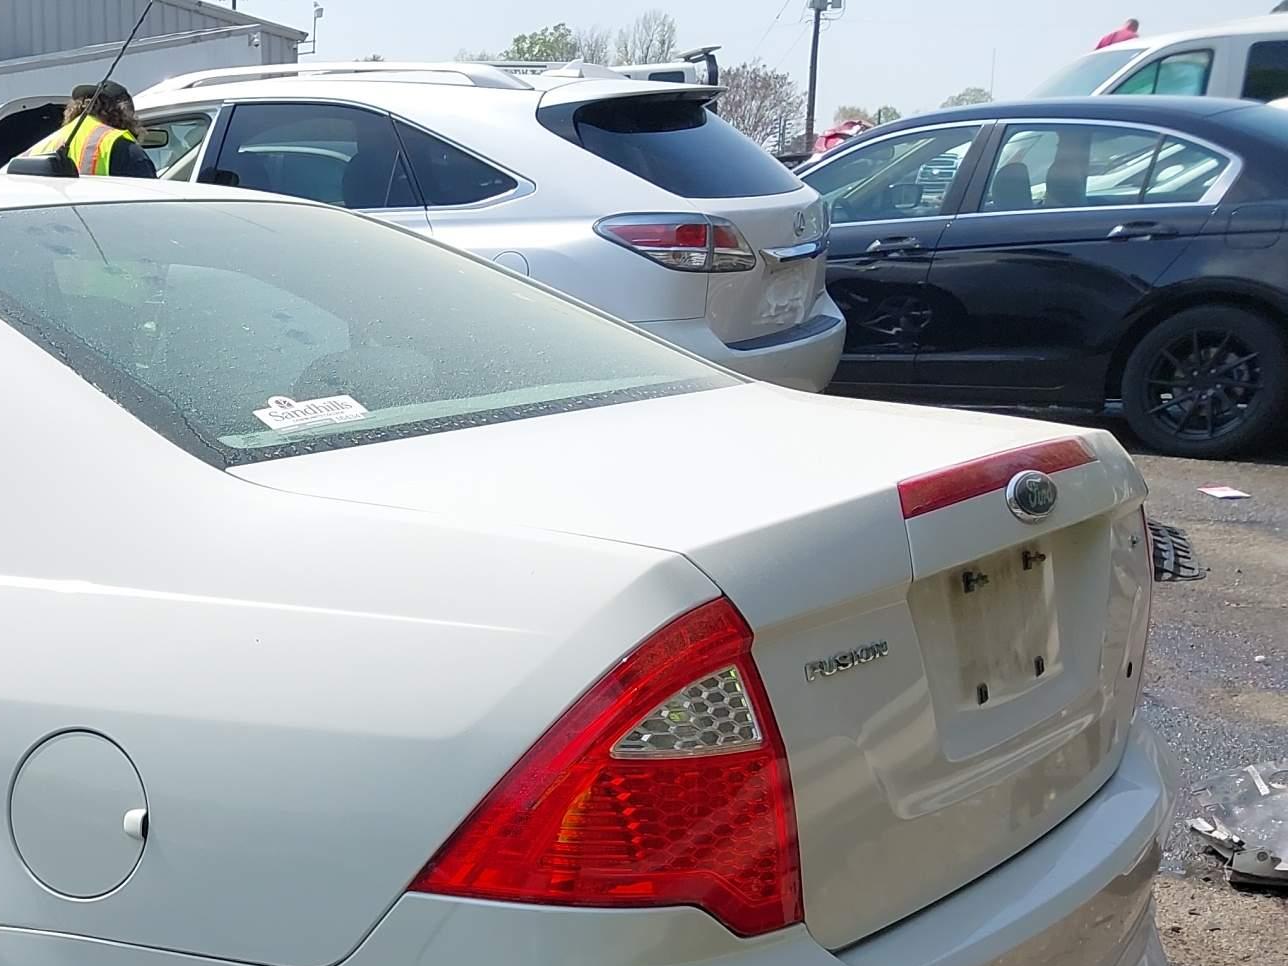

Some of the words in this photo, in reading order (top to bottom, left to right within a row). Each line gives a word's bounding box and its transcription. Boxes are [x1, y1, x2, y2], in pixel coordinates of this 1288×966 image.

[268, 400, 353, 422] Sandhills
[1025, 477, 1054, 508] Ford
[804, 639, 889, 682] FUSION
